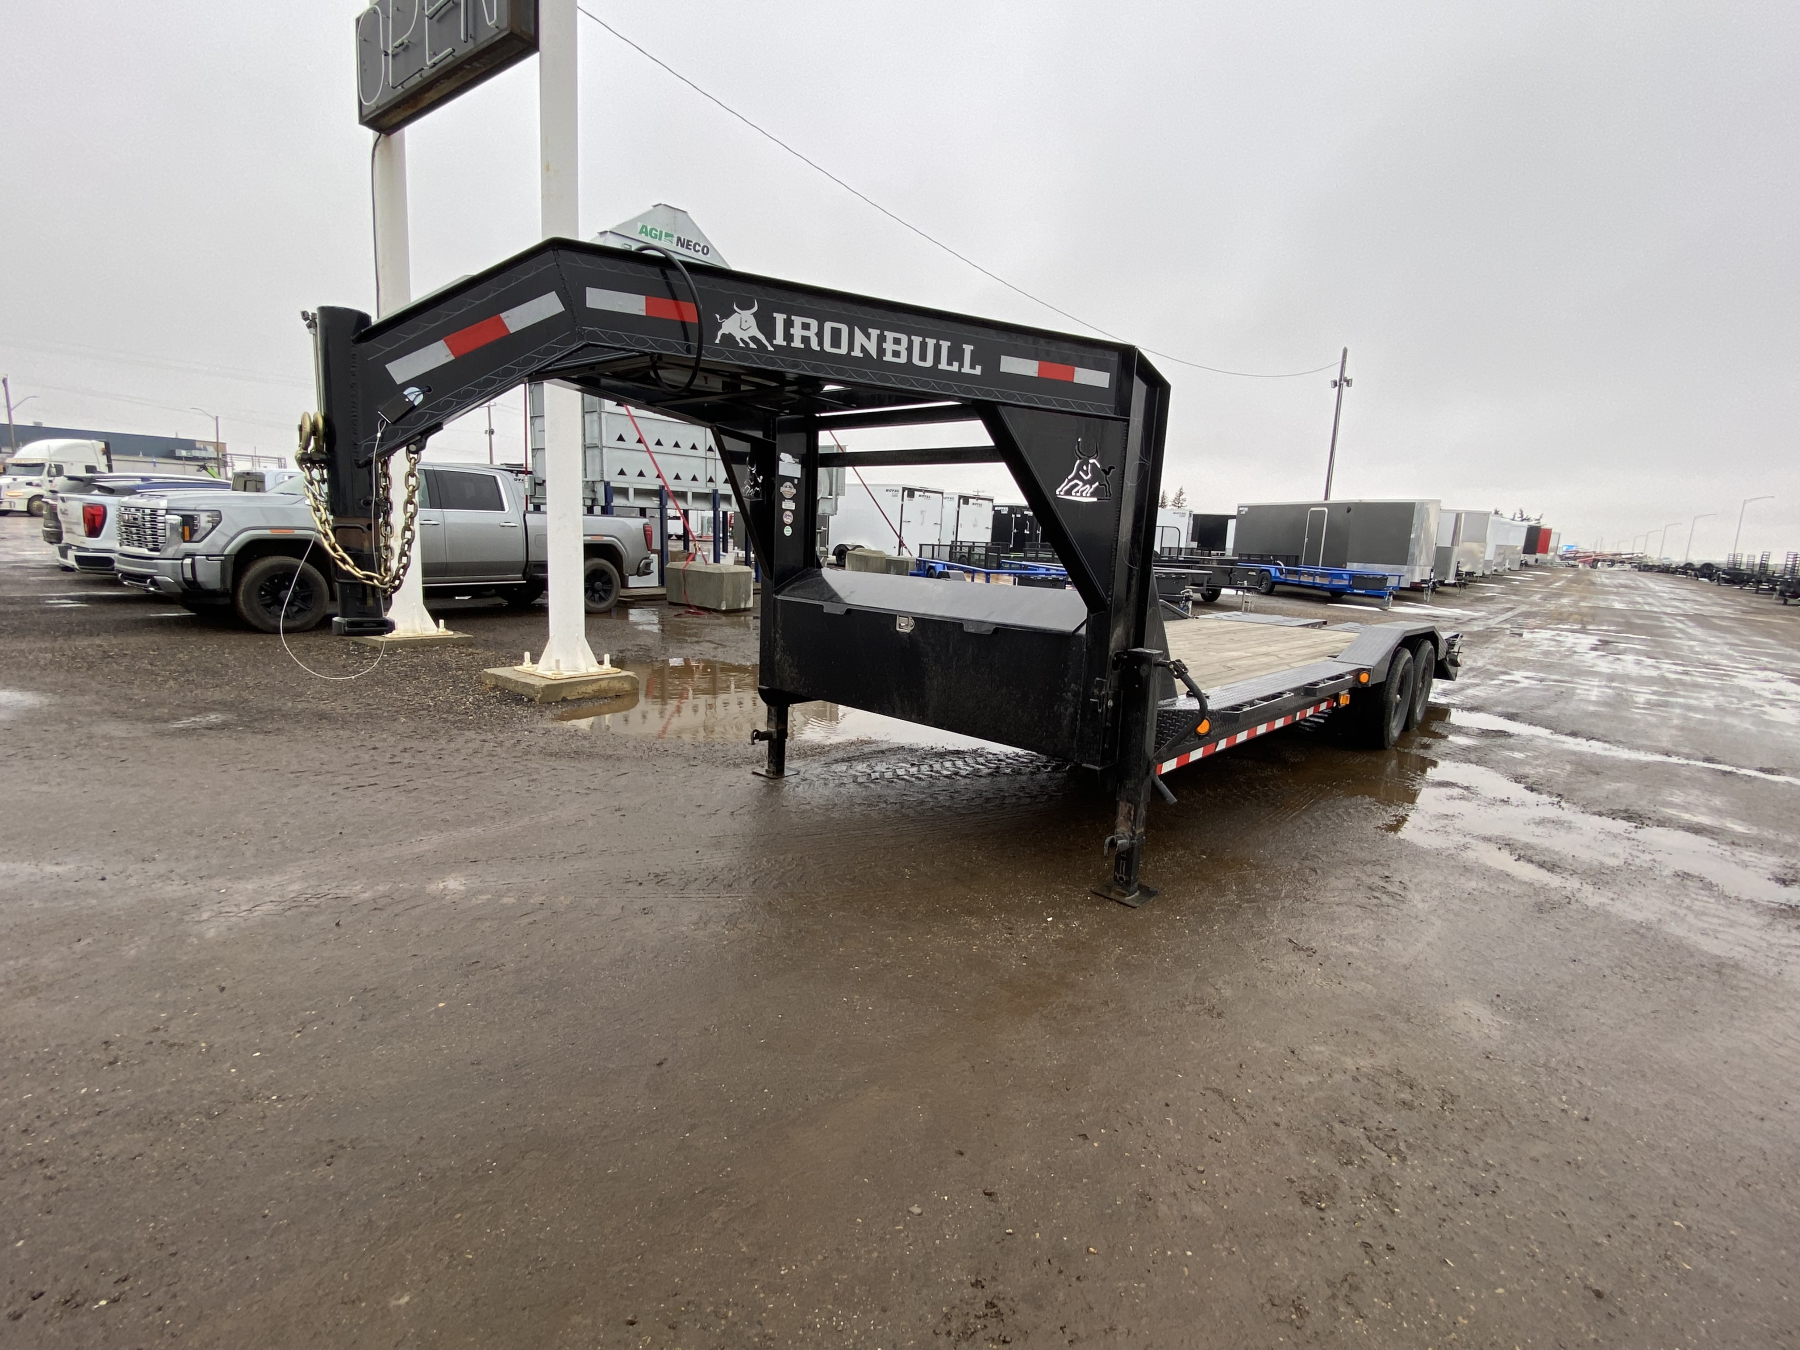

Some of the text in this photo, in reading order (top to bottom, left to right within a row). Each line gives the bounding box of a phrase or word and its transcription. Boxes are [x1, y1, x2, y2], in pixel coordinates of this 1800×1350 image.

[638, 224, 710, 256] AGI NECO
[773, 312, 982, 375] IRONBULL
